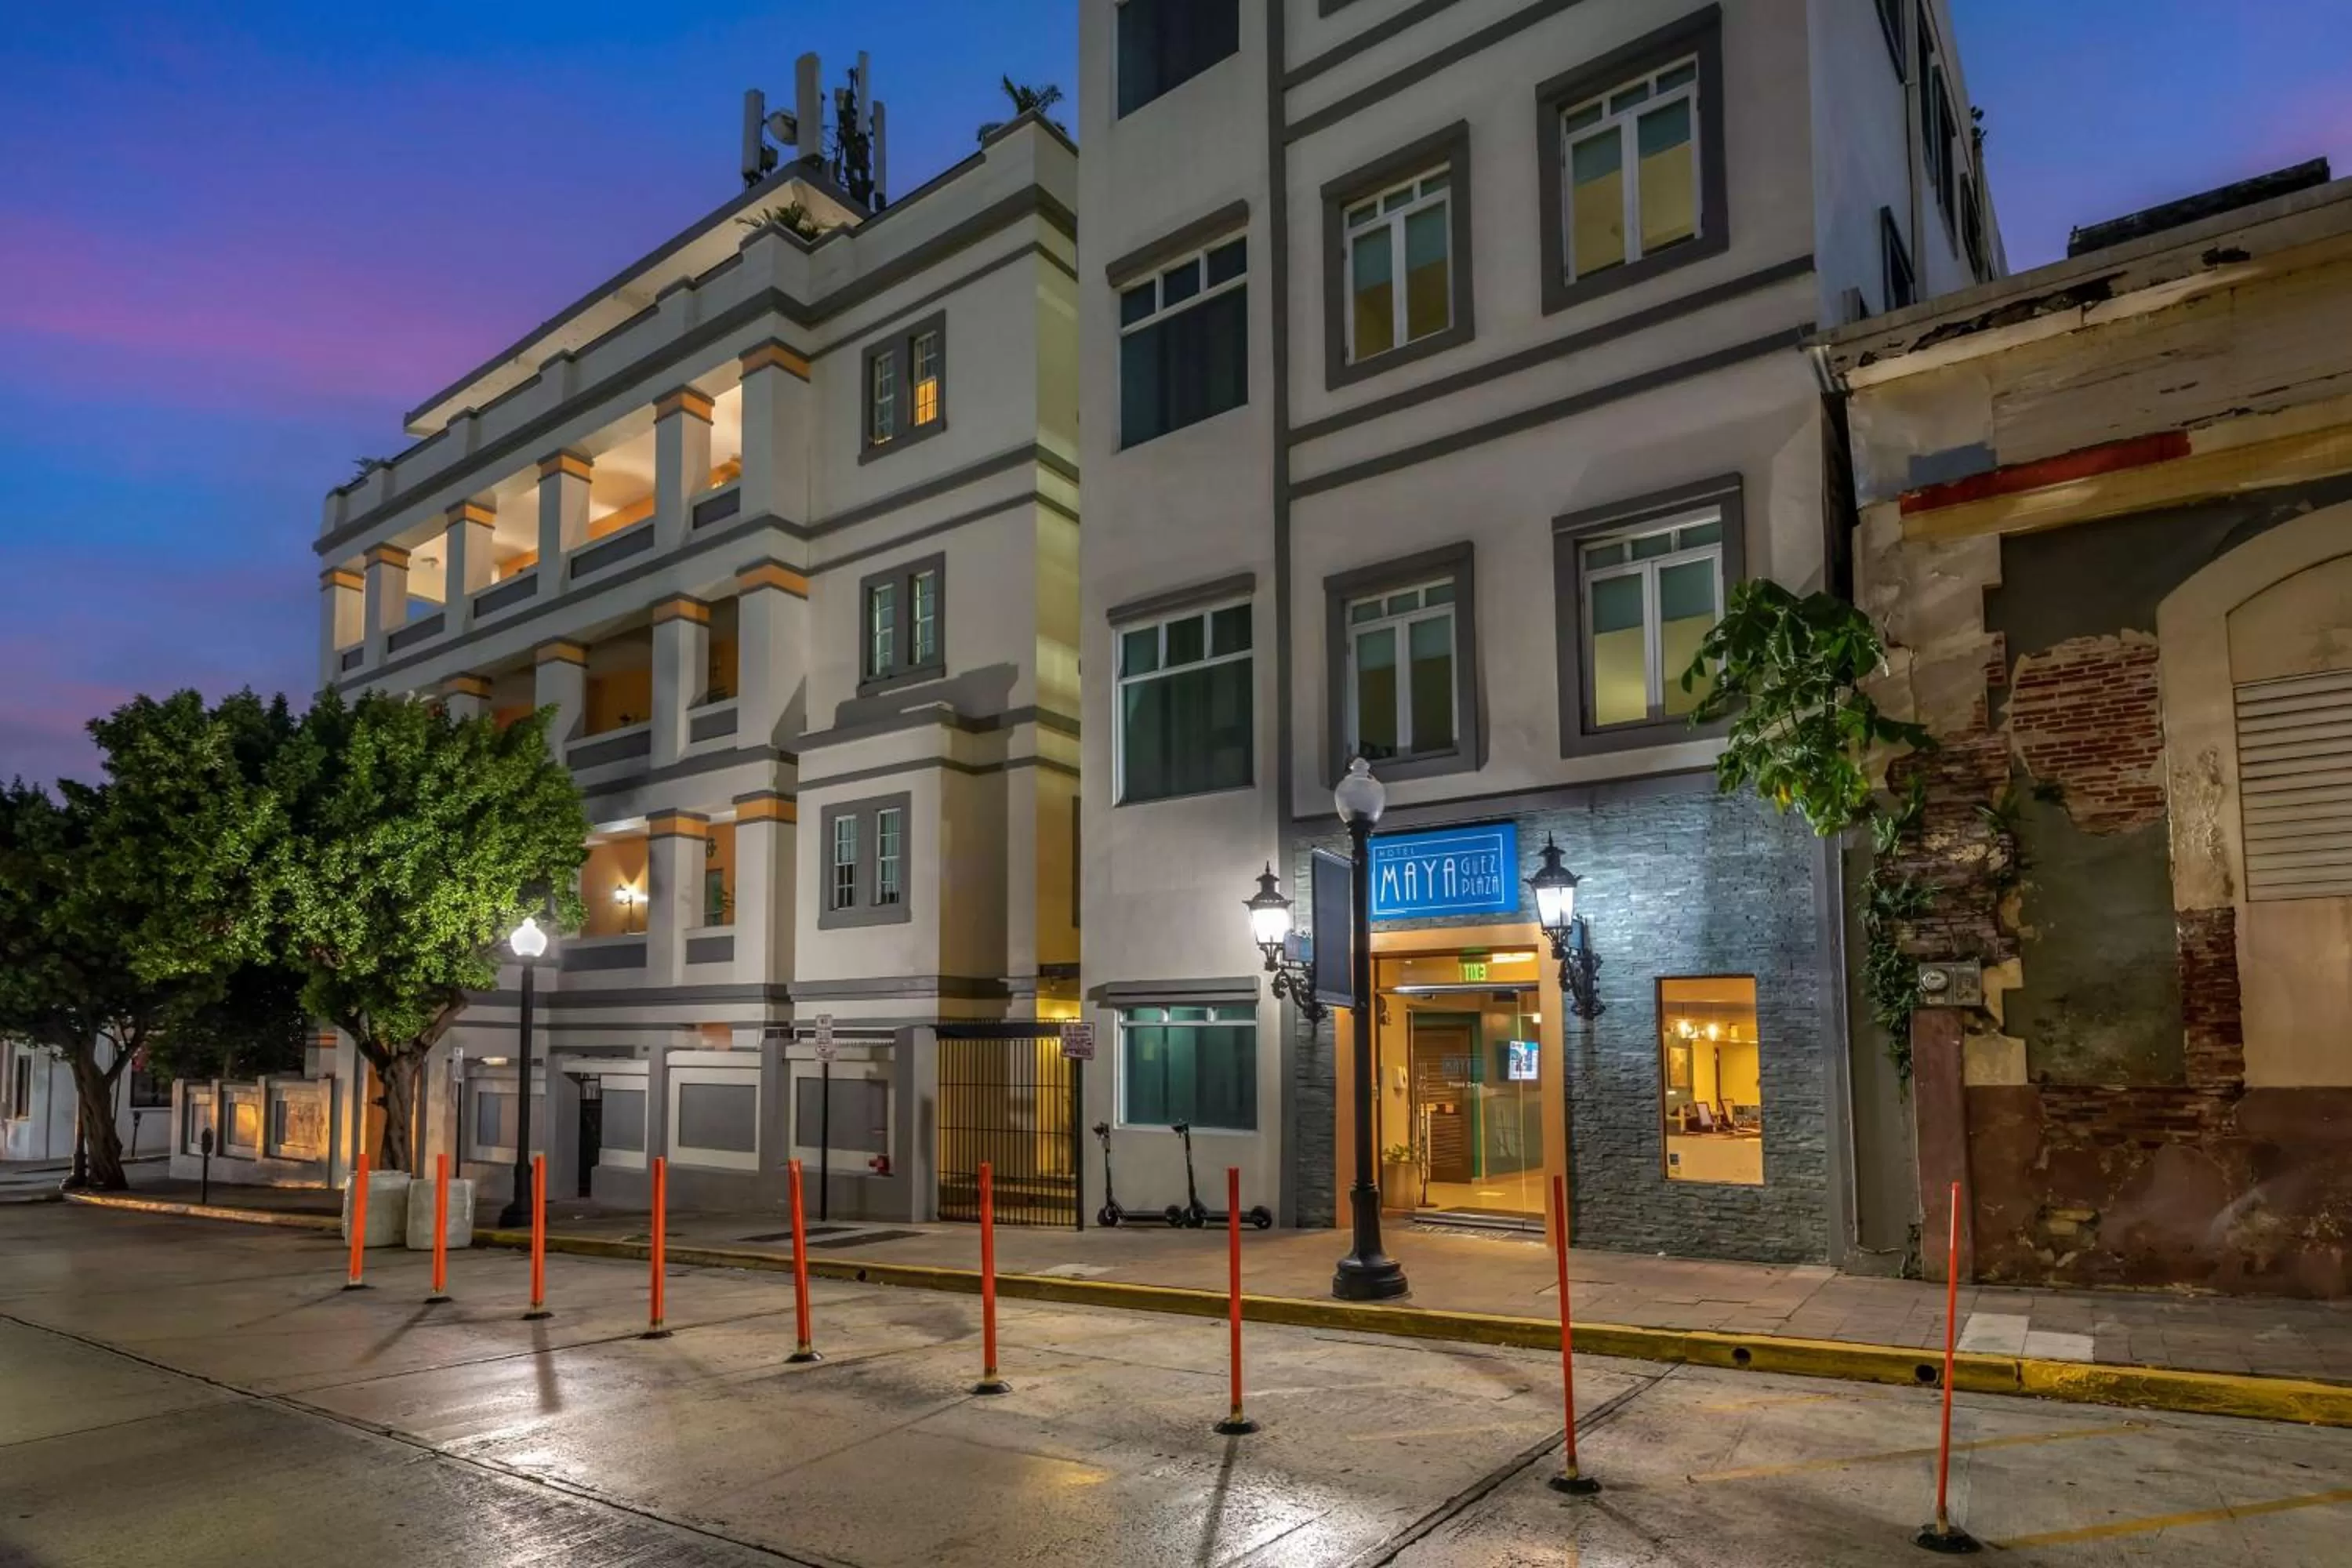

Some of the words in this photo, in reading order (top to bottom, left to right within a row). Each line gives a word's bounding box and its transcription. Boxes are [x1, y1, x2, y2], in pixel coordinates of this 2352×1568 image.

[1379, 847, 1415, 857] HOTEL
[1380, 857, 1457, 903] MAYA
[1461, 876, 1499, 897] PLAZA
